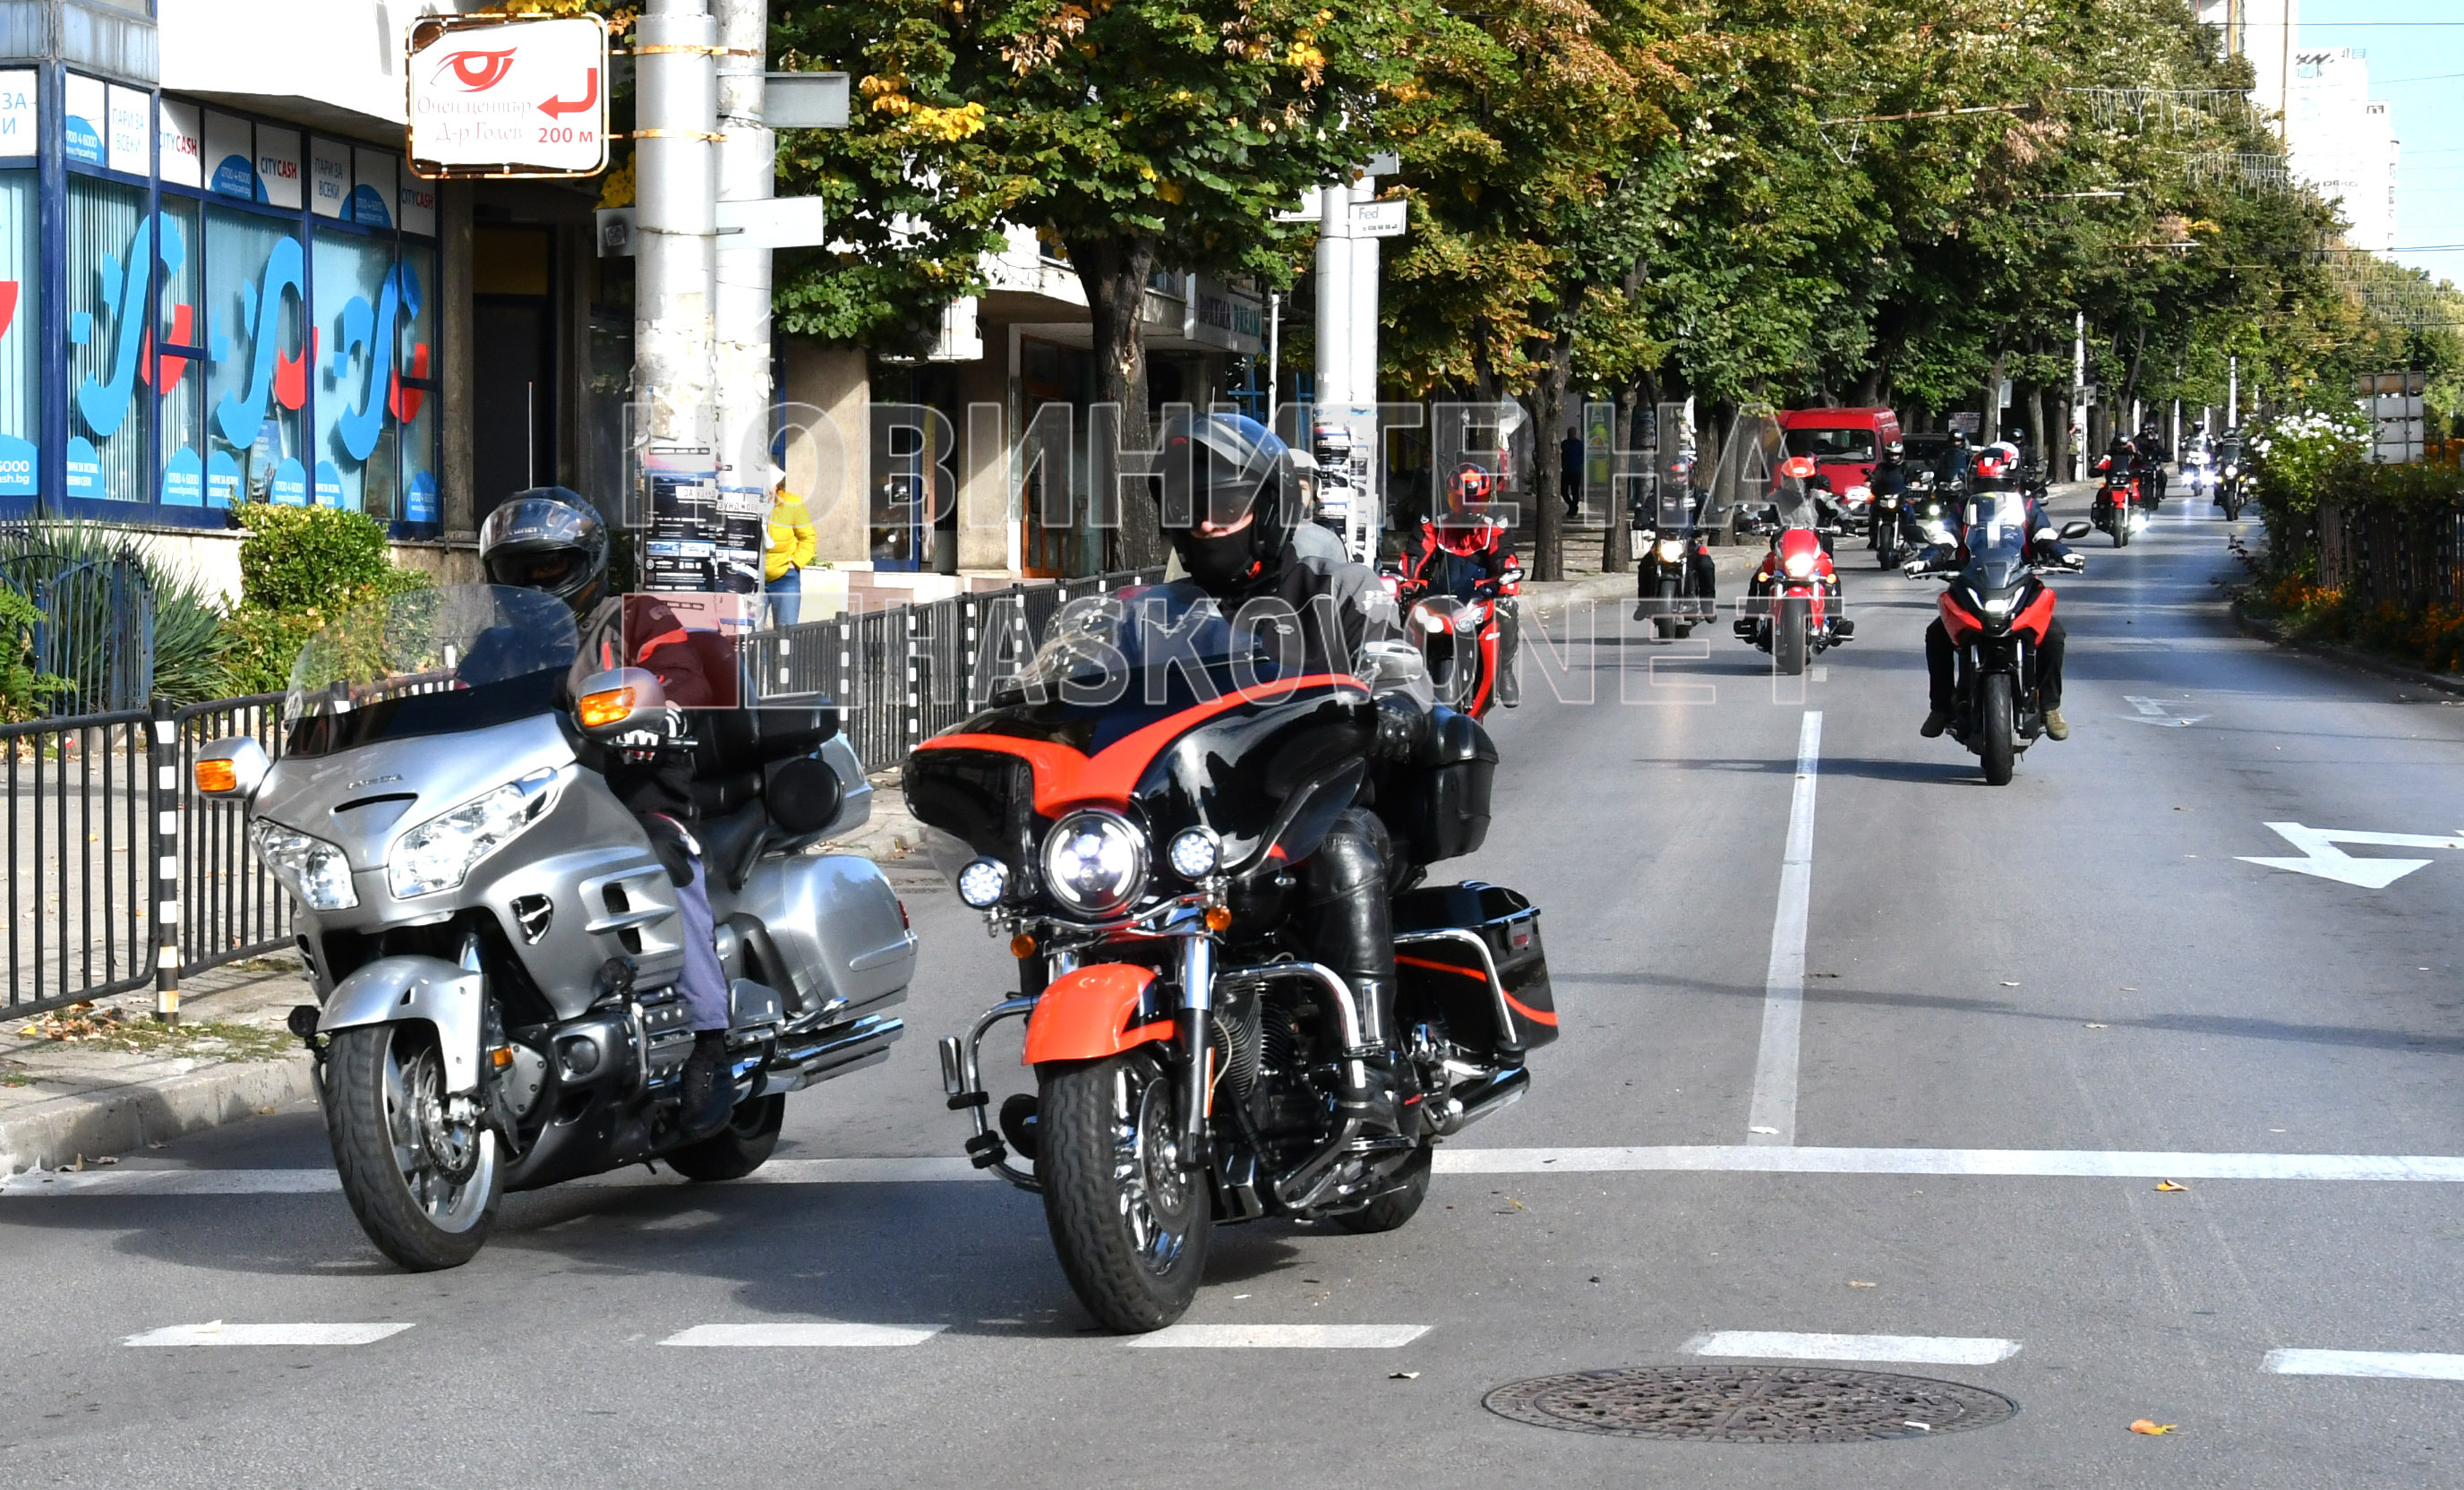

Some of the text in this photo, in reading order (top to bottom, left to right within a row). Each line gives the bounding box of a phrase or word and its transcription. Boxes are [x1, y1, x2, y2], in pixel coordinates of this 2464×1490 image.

[2, 92, 27, 109] ЗА
[417, 96, 460, 114] Очен
[112, 108, 133, 126] ПАРИ
[82, 134, 98, 149] 6000
[116, 134, 141, 152] ВСЕКИ
[435, 122, 469, 148] Д-р
[537, 127, 594, 143] 200 м
[159, 132, 197, 157] ITYCASH
[261, 157, 297, 179] CITYCASH
[1358, 206, 1379, 219] Fed
